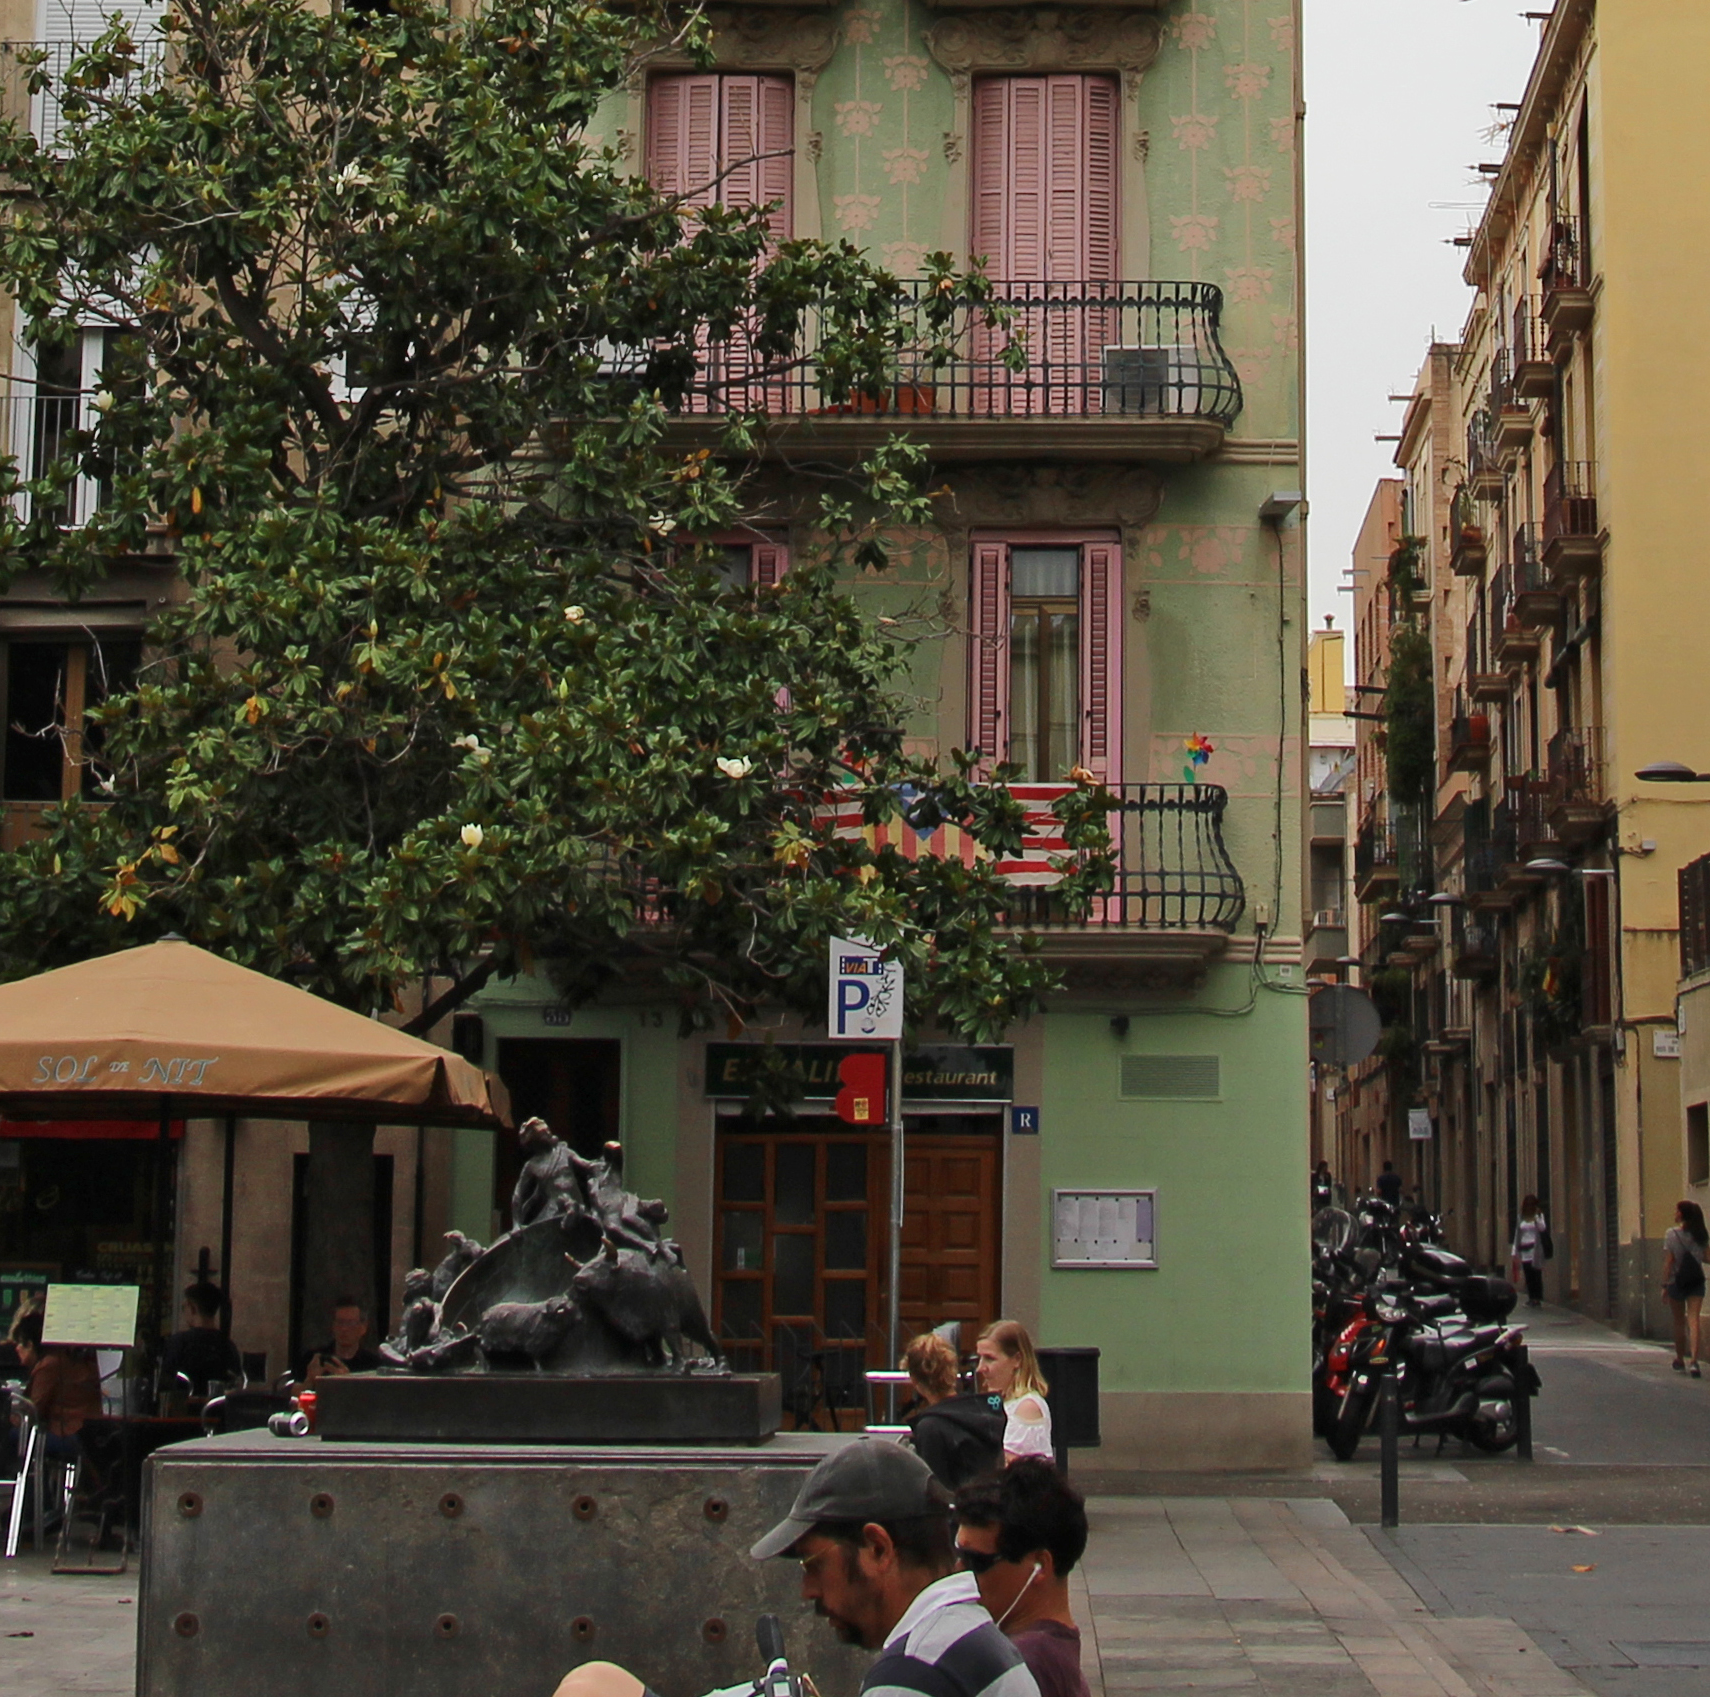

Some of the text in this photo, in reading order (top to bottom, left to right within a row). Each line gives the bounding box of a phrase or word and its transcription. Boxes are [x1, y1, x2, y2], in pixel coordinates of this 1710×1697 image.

[837, 979, 870, 1035] P
[32, 1056, 219, 1086] SOL DE NIT
[903, 1070, 997, 1085] estaurant
[1020, 1113, 1031, 1127] R
